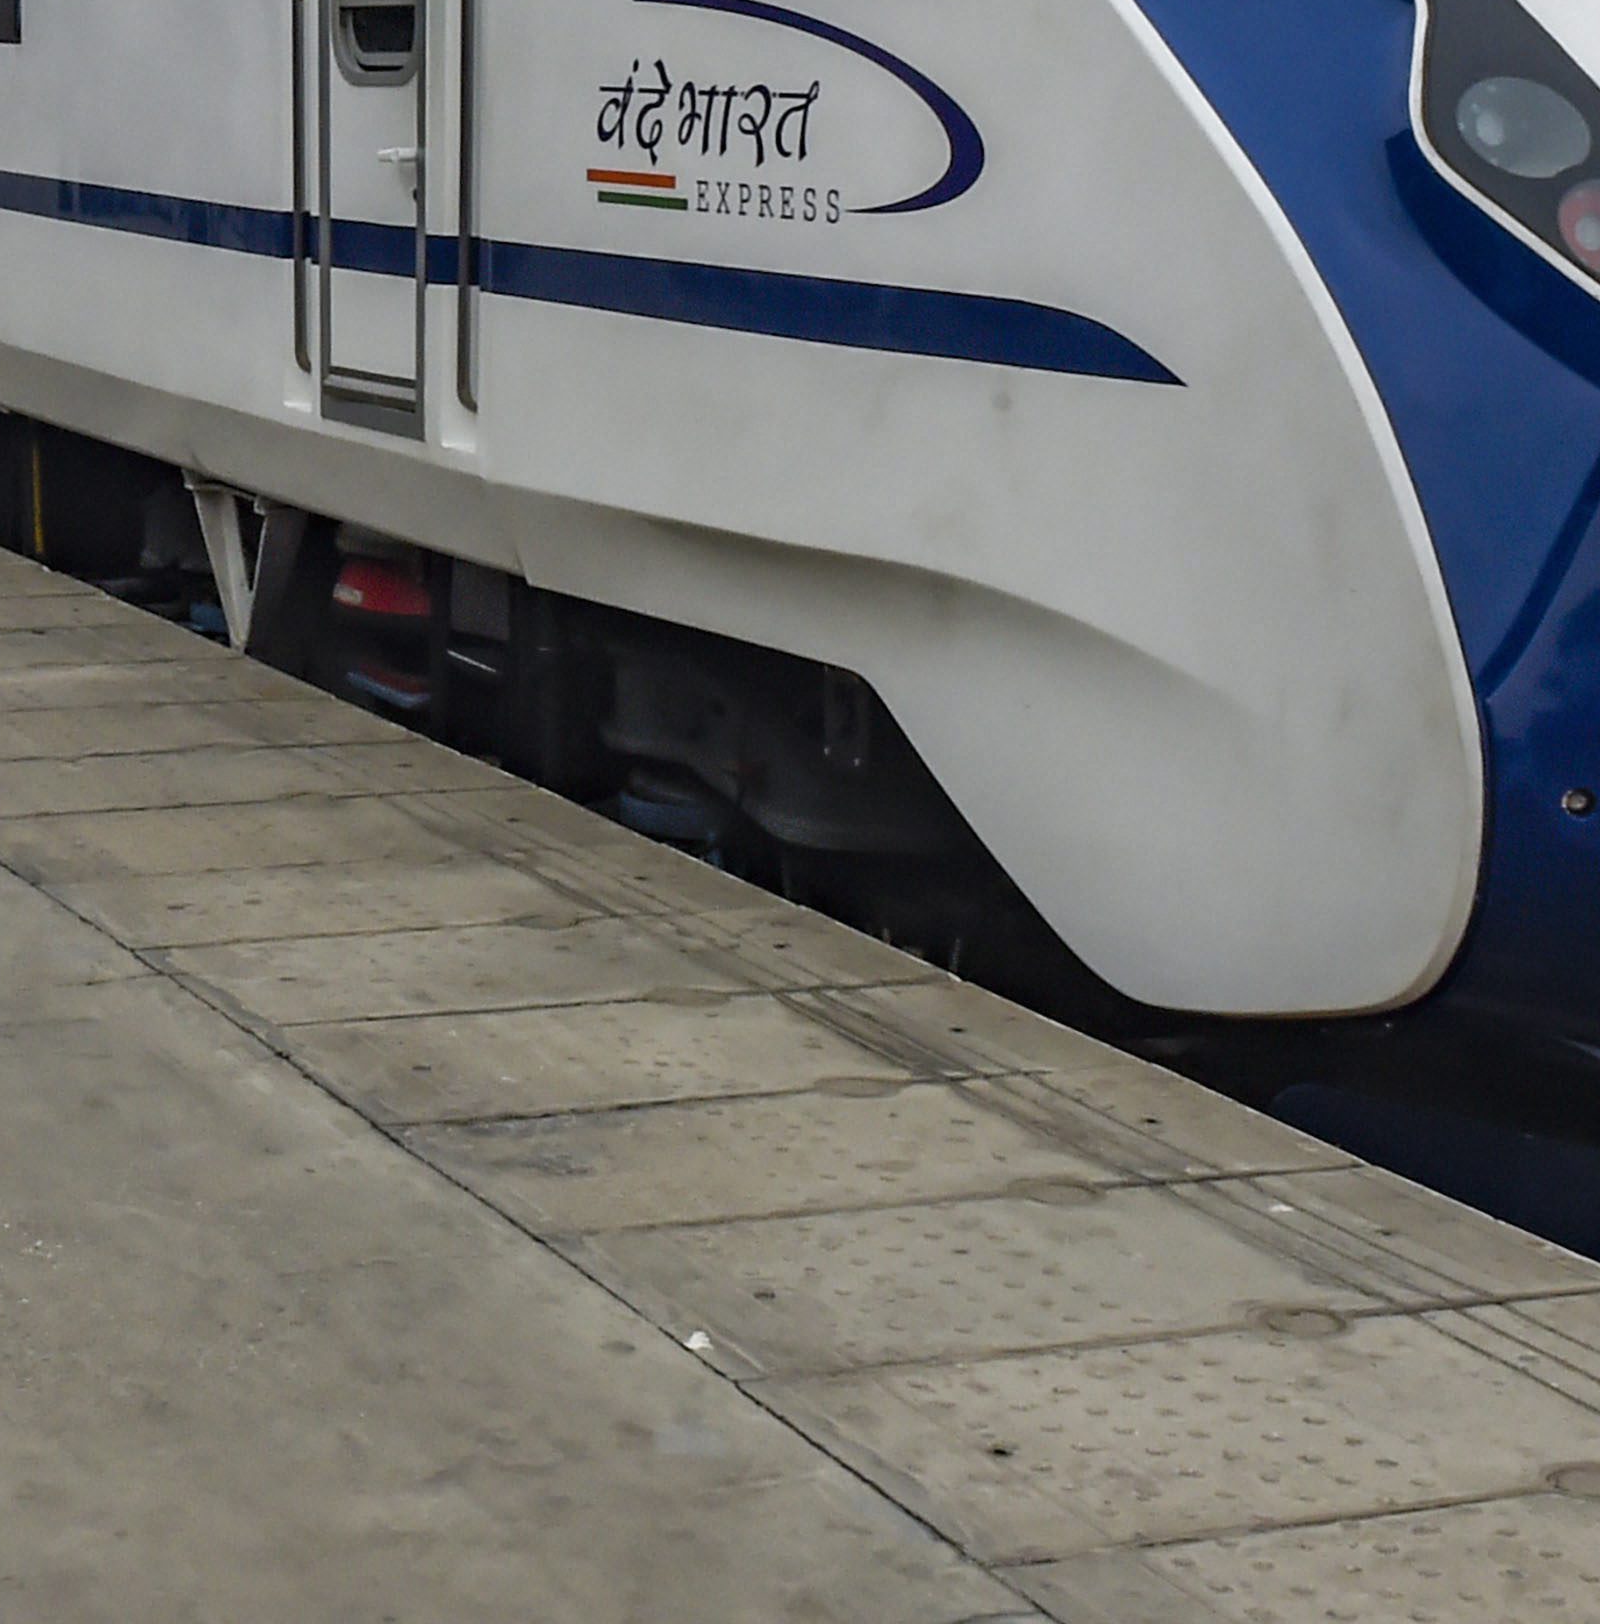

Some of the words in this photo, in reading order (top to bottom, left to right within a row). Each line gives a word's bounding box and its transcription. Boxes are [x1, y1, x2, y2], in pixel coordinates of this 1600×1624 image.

[596, 58, 673, 167] वंदे
[677, 80, 820, 168] भारत
[695, 179, 842, 225] EXPRESS
